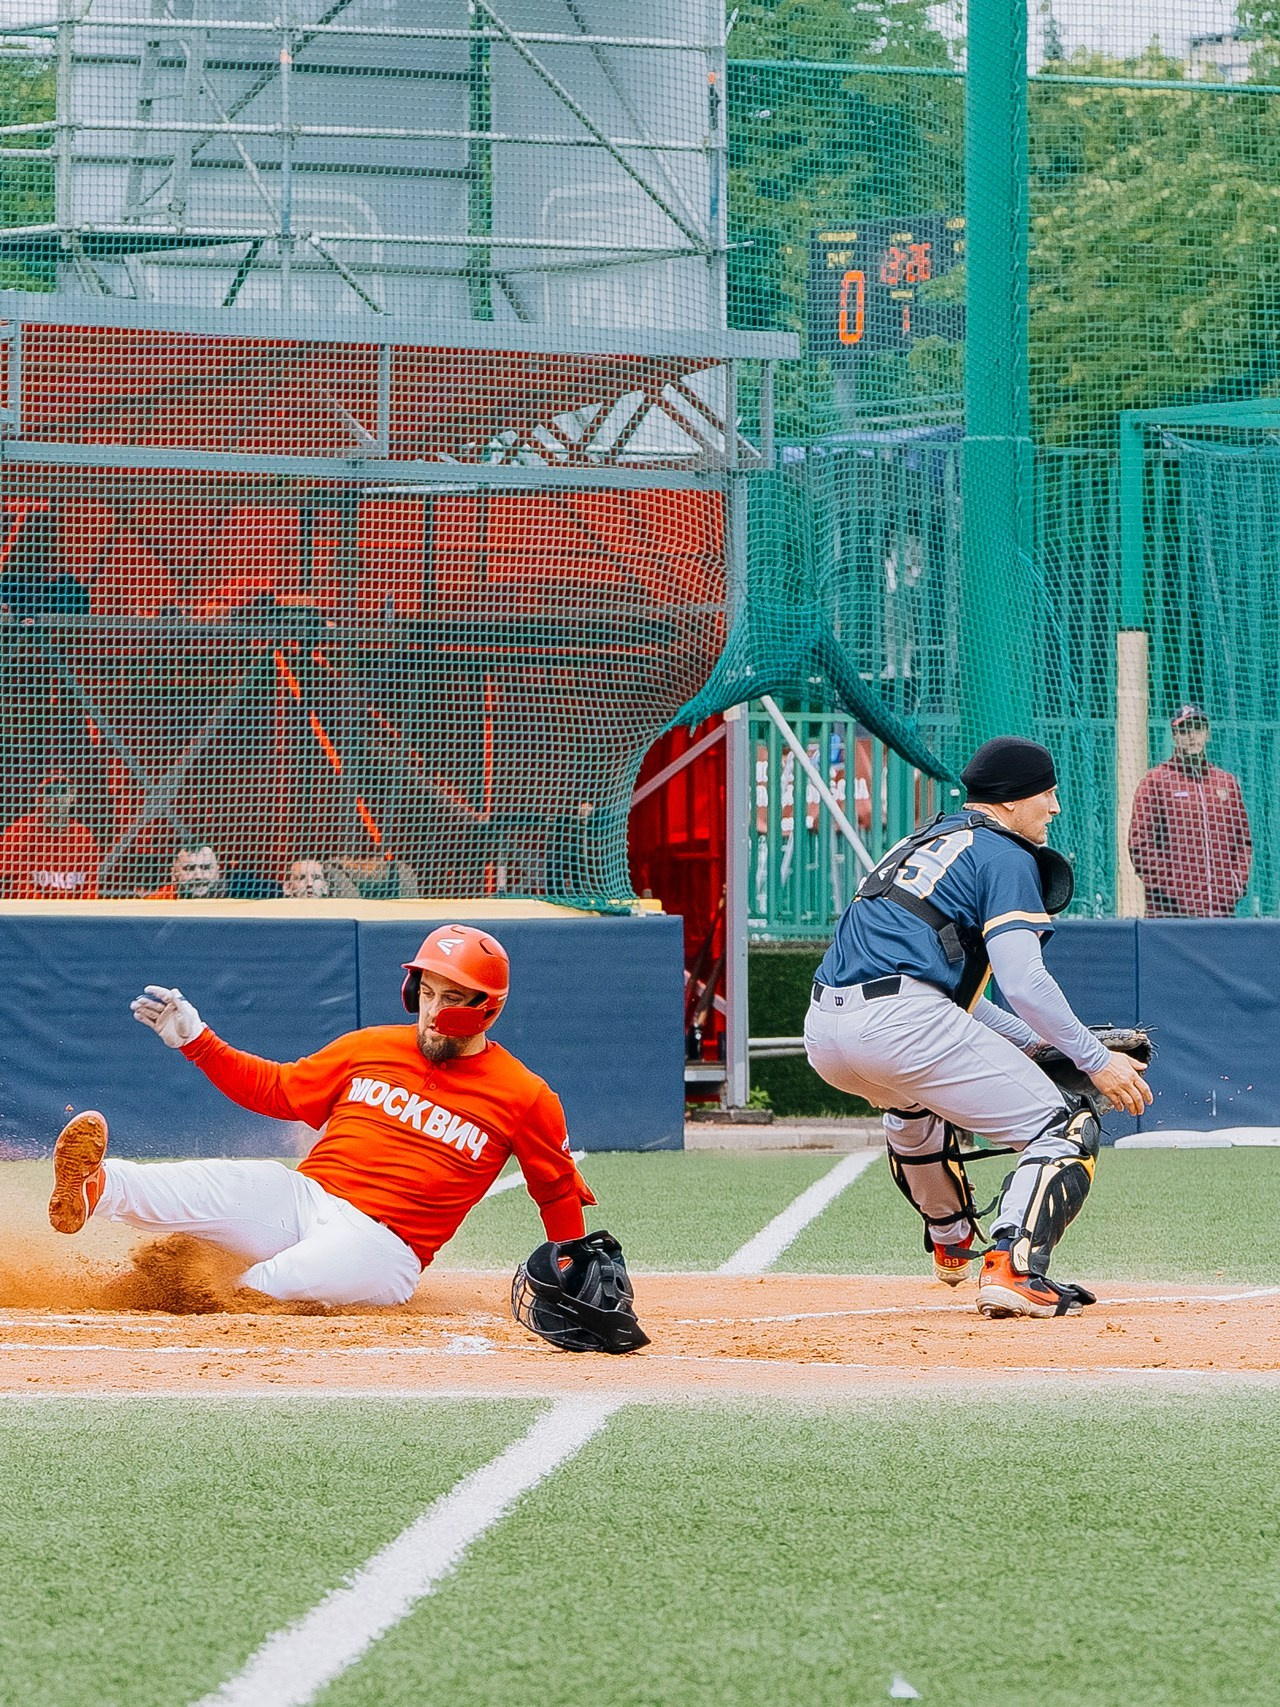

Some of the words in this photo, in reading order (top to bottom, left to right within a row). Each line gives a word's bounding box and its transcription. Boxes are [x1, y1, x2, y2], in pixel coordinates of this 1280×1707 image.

[839, 270, 865, 345] 0
[856, 829, 974, 902] 9
[347, 1077, 489, 1161] МОСКВИЧ
[944, 1258, 959, 1267] 99
